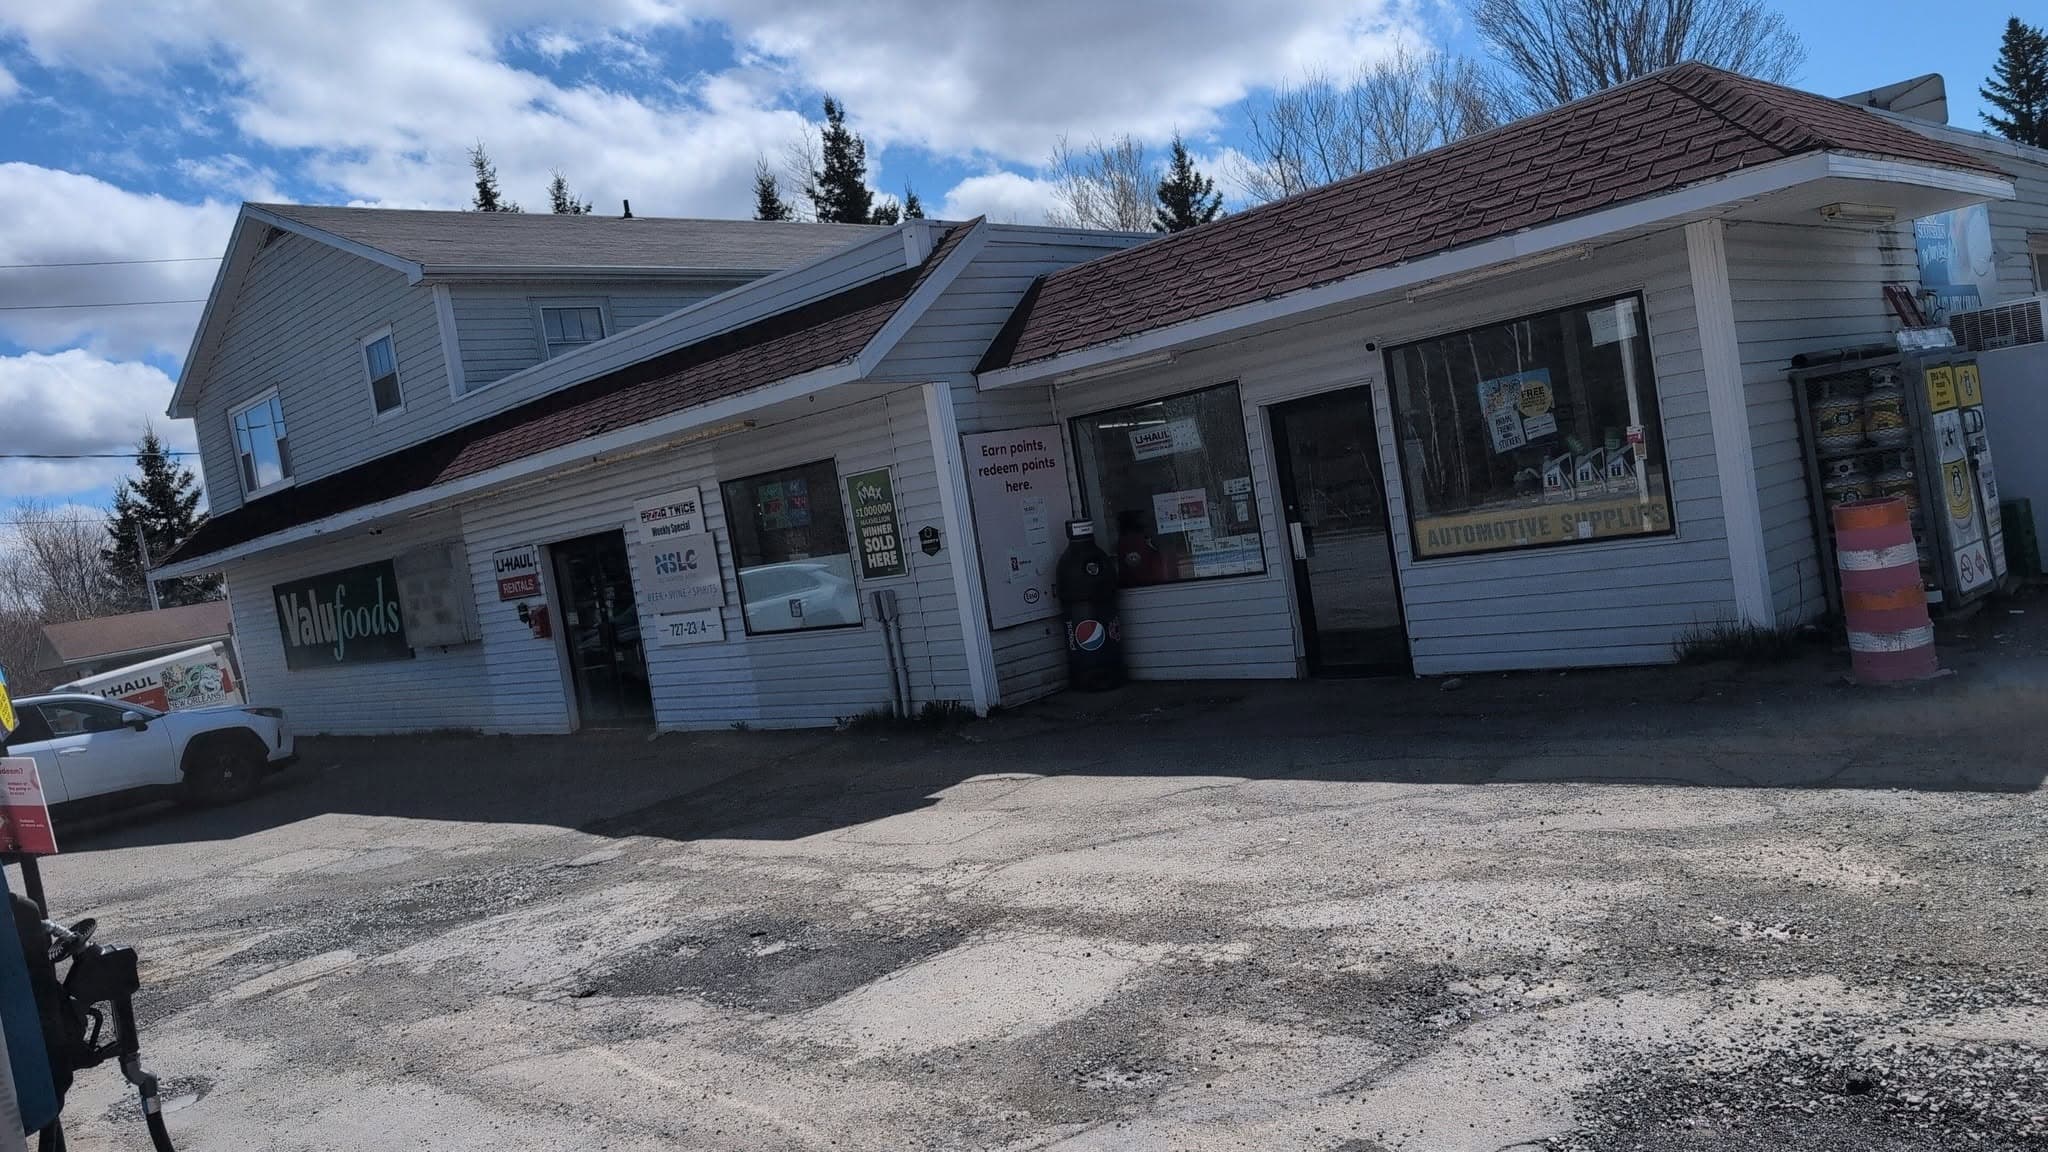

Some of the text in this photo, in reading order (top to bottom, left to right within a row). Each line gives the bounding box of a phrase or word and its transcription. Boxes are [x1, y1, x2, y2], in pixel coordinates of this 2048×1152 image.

[1521, 386, 1545, 399] FREE
[982, 440, 1047, 457] Earn points,
[979, 457, 1056, 477] redeem points
[1005, 480, 1033, 493] here.
[668, 501, 696, 516] TWICE
[651, 519, 691, 537] Weekly Special
[861, 523, 893, 538] WINNER
[1427, 516, 1551, 548] AUTOMOTIVE
[864, 535, 896, 553] SOLD
[496, 553, 533, 573] U-HAUL
[654, 549, 698, 575] NSLC
[867, 550, 898, 569] HERE
[502, 578, 535, 595] RENTALS
[669, 620, 706, 637] 727-234
